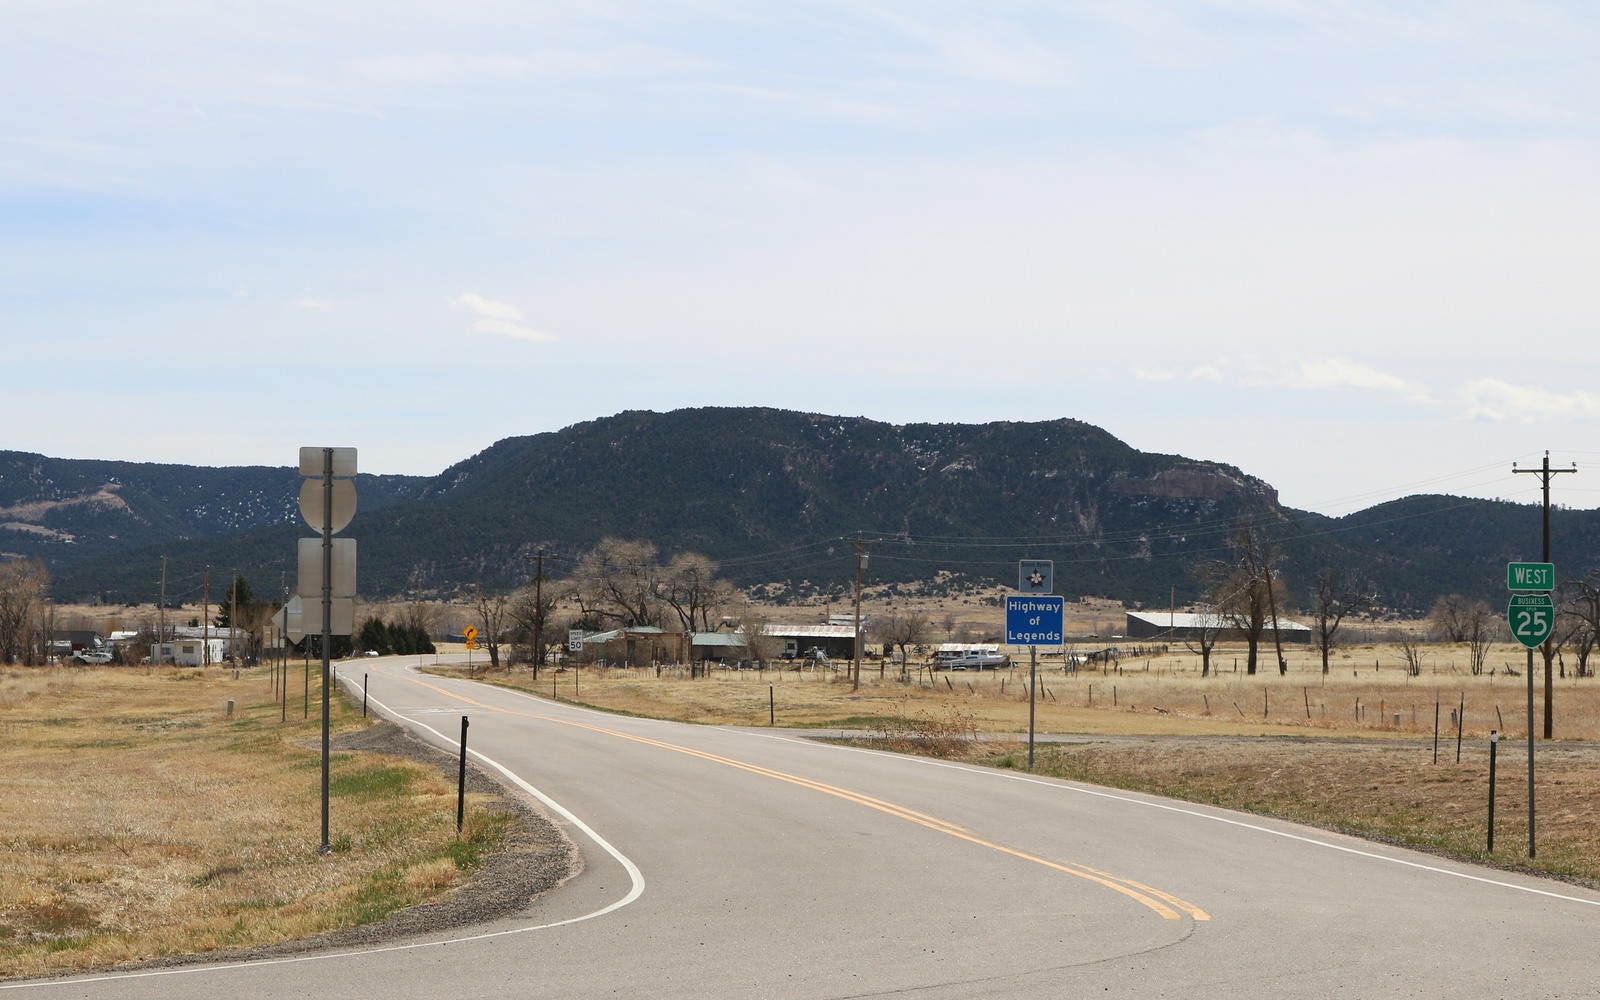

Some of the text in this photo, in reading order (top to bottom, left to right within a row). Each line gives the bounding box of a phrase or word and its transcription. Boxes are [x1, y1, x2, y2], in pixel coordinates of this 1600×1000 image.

[1514, 567, 1548, 584] WEST
[1009, 601, 1060, 613] Highway
[1518, 597, 1545, 605] BUSINESS
[1029, 616, 1041, 626] of
[1516, 611, 1548, 636] 25
[1008, 630, 1060, 643] Legends
